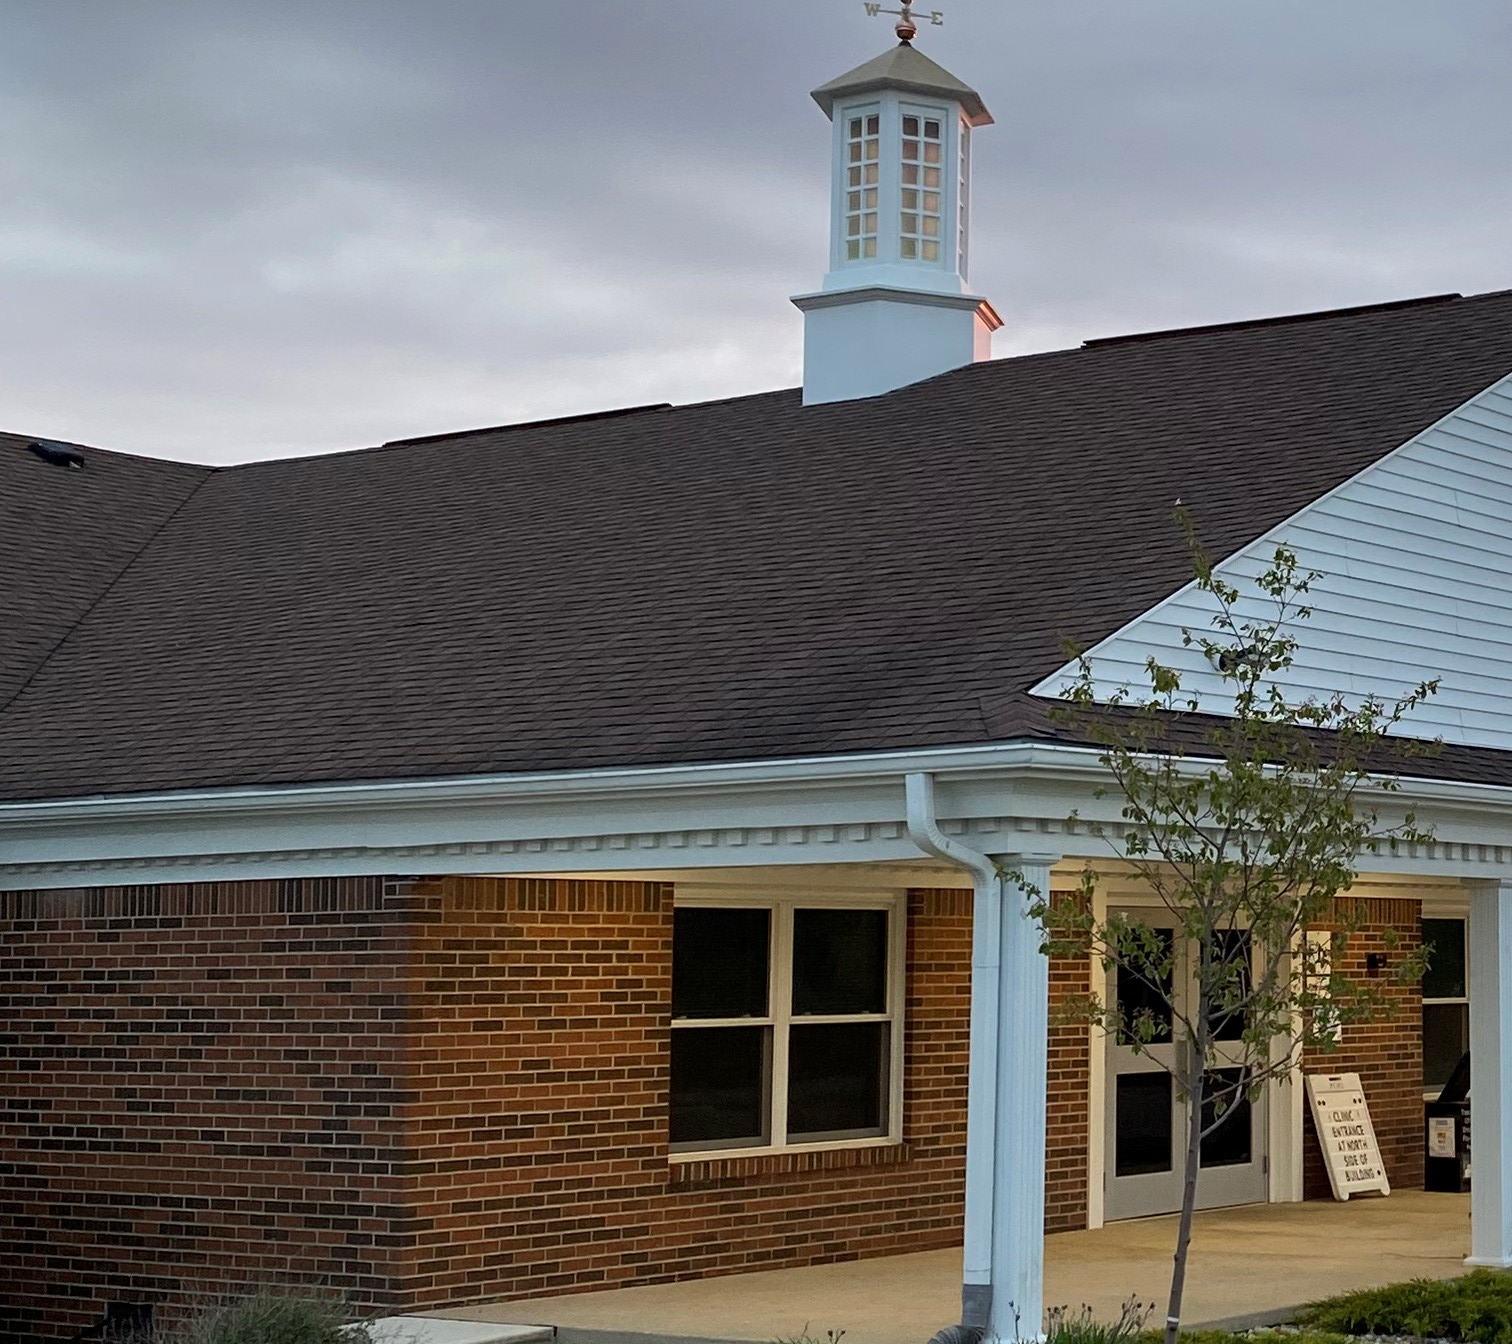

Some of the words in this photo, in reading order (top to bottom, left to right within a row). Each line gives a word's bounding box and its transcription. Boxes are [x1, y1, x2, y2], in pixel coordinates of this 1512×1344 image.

[1332, 1125, 1364, 1137] ENTRANCE
[1338, 1140, 1346, 1152] AT
[1347, 1139, 1368, 1151] NORTH
[1343, 1155, 1359, 1167] SIDE
[1360, 1153, 1368, 1165] OF
[1345, 1168, 1375, 1182] BUILDING
